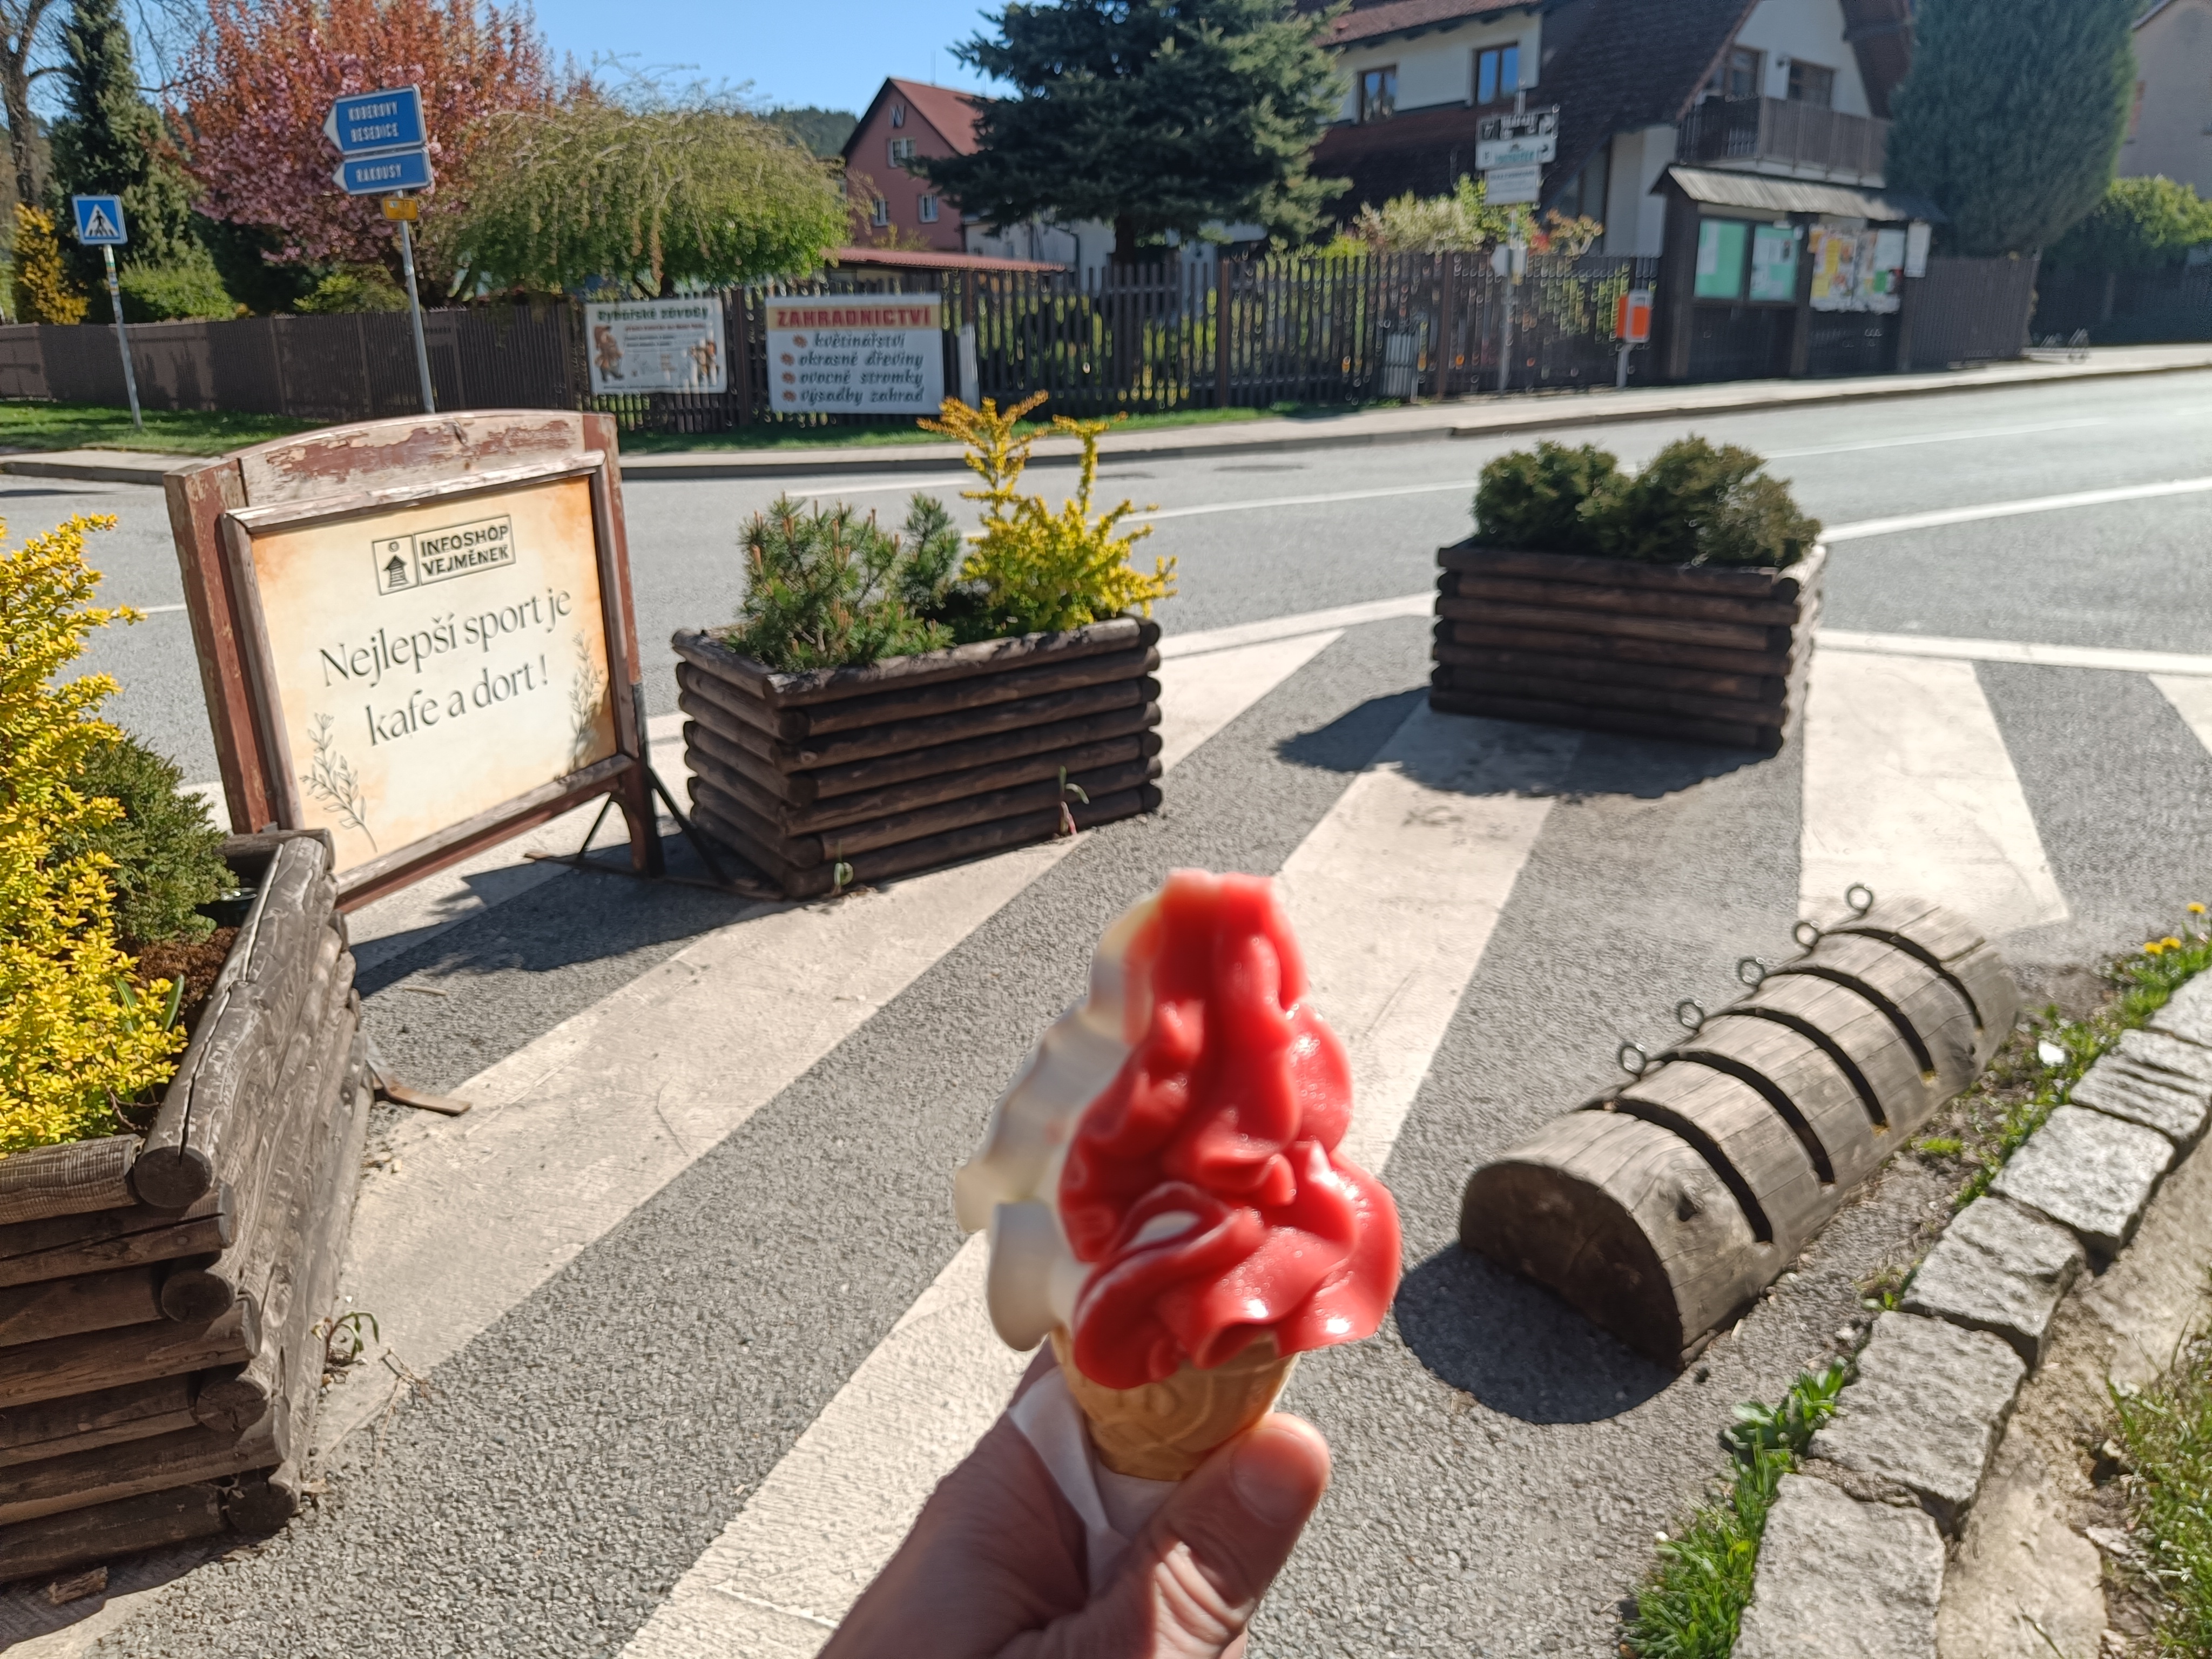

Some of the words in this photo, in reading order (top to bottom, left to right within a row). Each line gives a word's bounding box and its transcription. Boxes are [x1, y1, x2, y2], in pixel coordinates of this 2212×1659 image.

[356, 164, 401, 182] RAKOUSY
[799, 352, 858, 366] okrasné
[866, 352, 923, 369] dřeviny
[799, 370, 851, 384] ovocné
[859, 369, 924, 388] stromky
[800, 387, 863, 406] výsadby
[871, 386, 925, 403] zahrad
[421, 526, 508, 557] INFOSHOP
[422, 545, 509, 575] VEJMĚNEK
[319, 612, 457, 687] Nejlepší
[464, 595, 544, 652] sport
[545, 588, 572, 633] je
[365, 689, 440, 746] kafe
[447, 690, 467, 718] a
